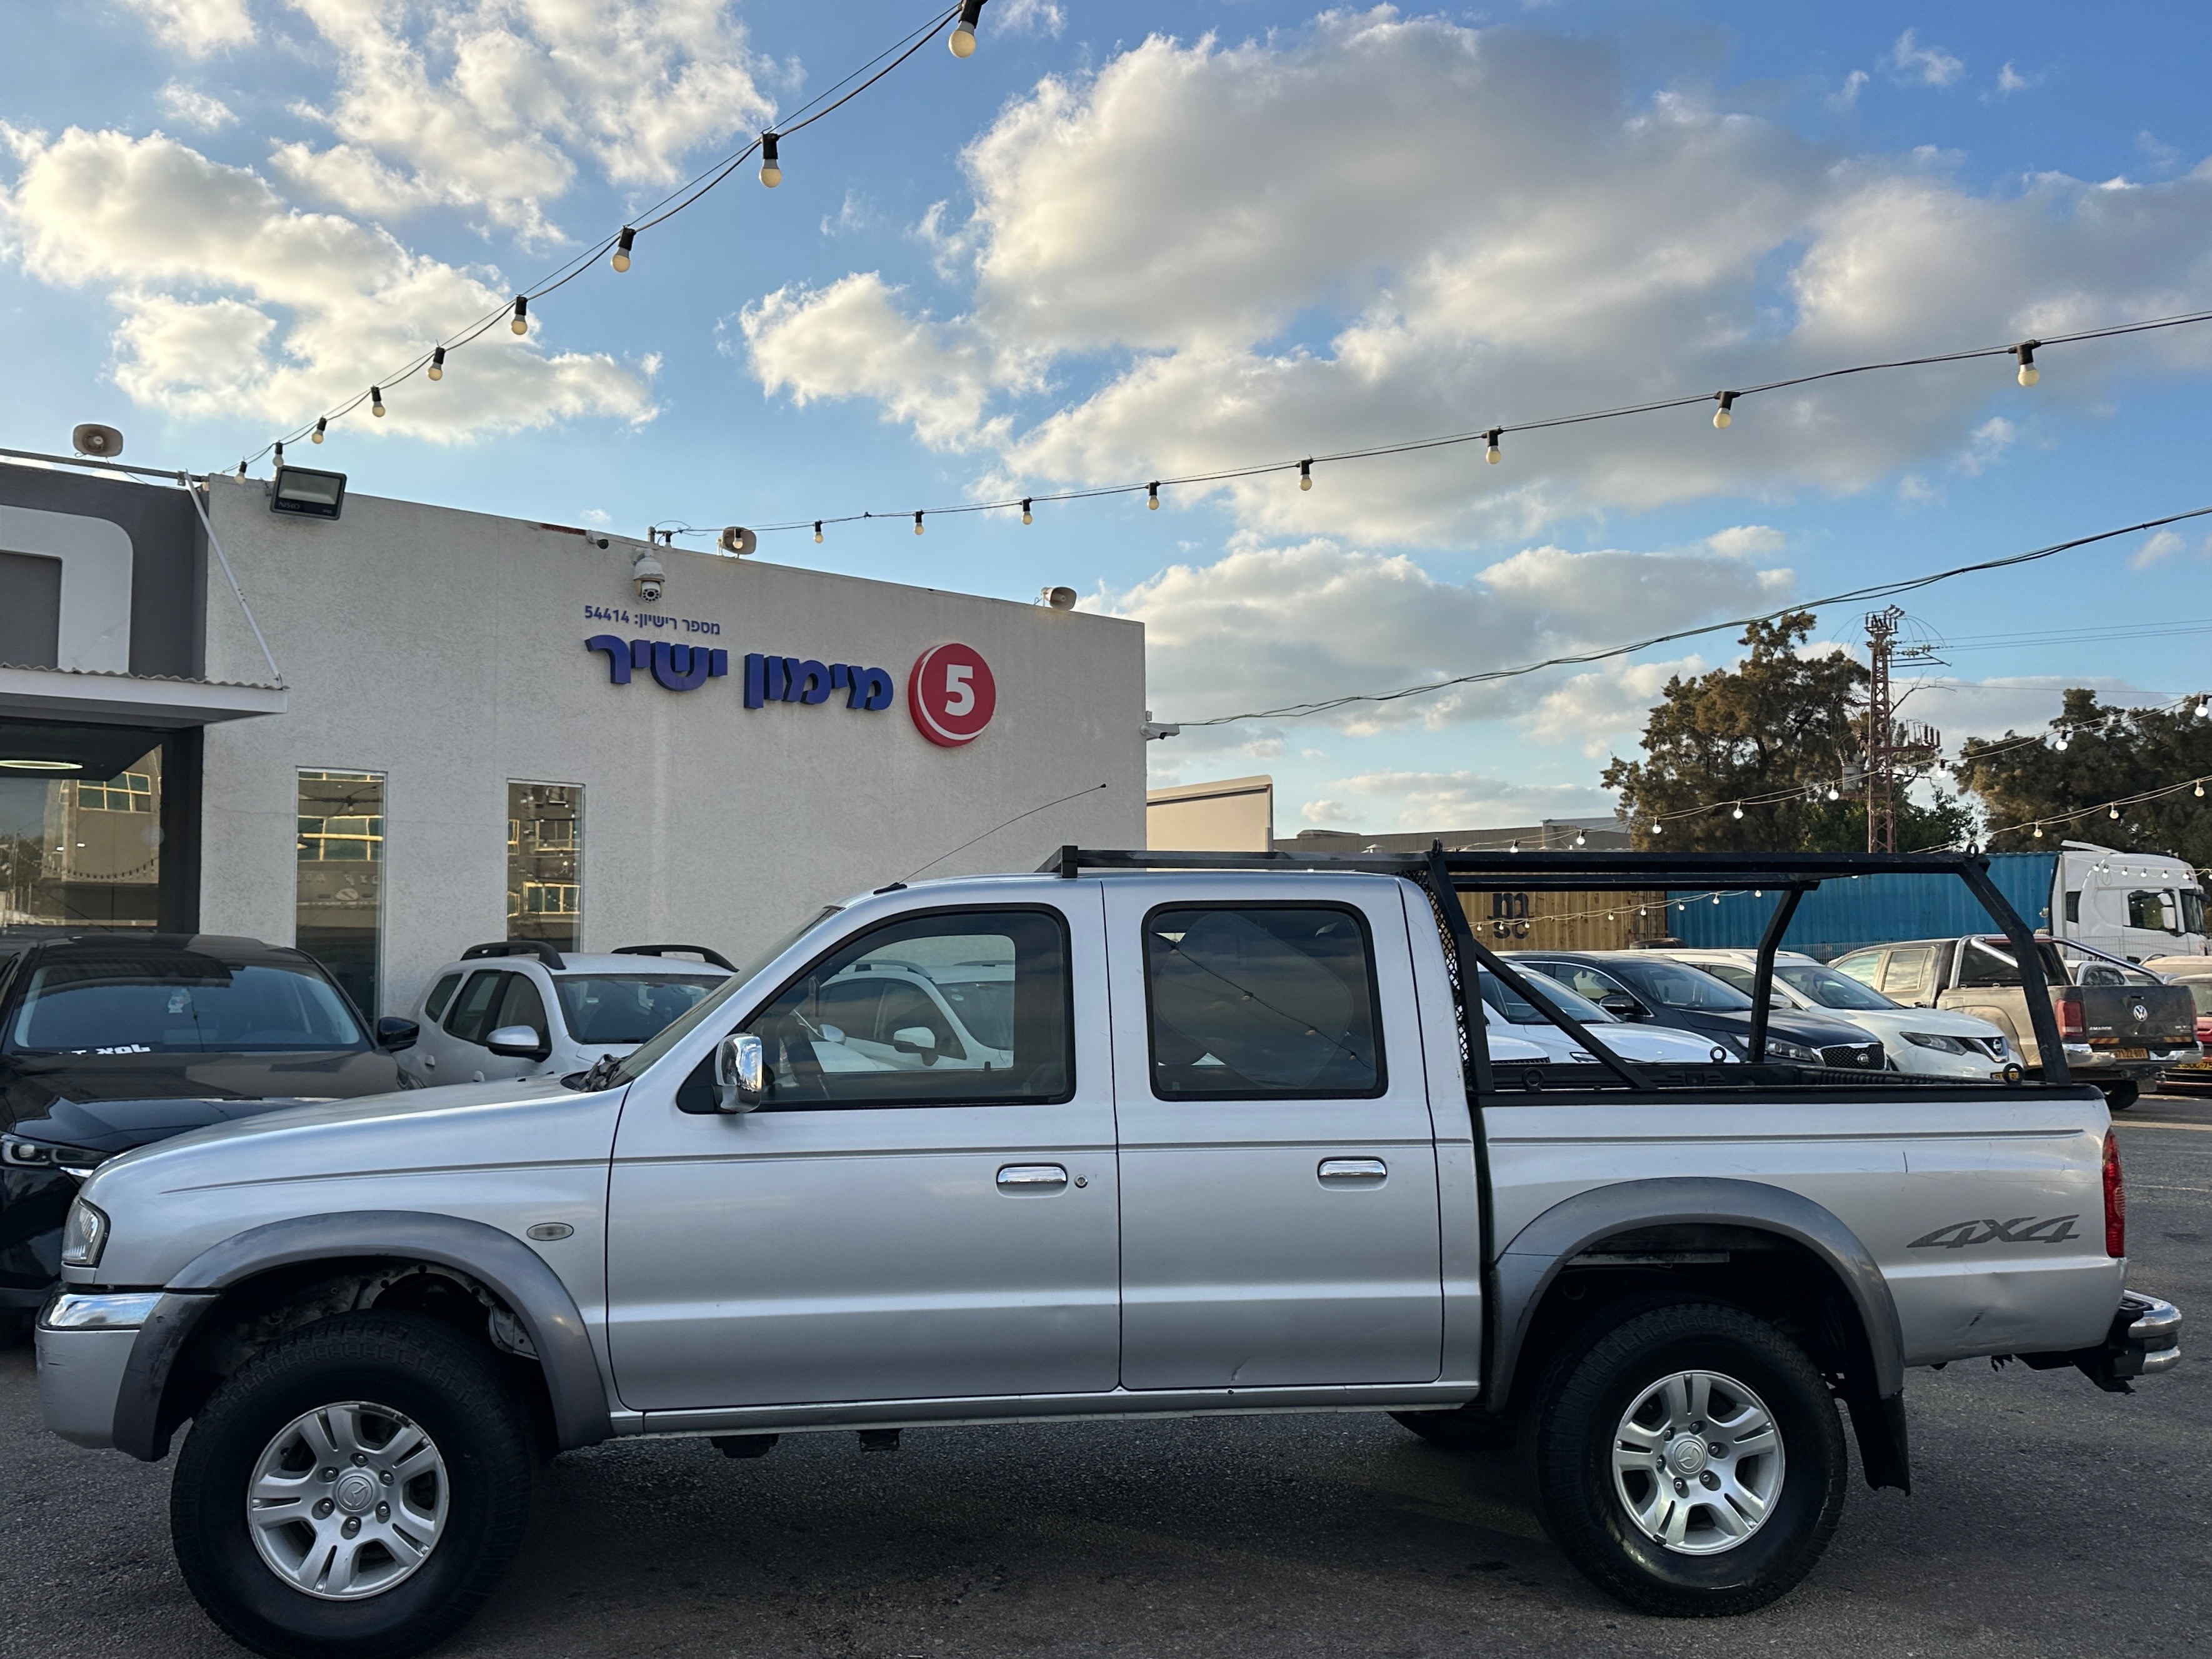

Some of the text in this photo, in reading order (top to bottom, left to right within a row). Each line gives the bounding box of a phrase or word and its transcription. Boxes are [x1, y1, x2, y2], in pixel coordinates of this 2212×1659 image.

[584, 605, 721, 635] מספר רישיון: 54414
[584, 634, 894, 711] מימון ישיר
[944, 664, 975, 716] 5
